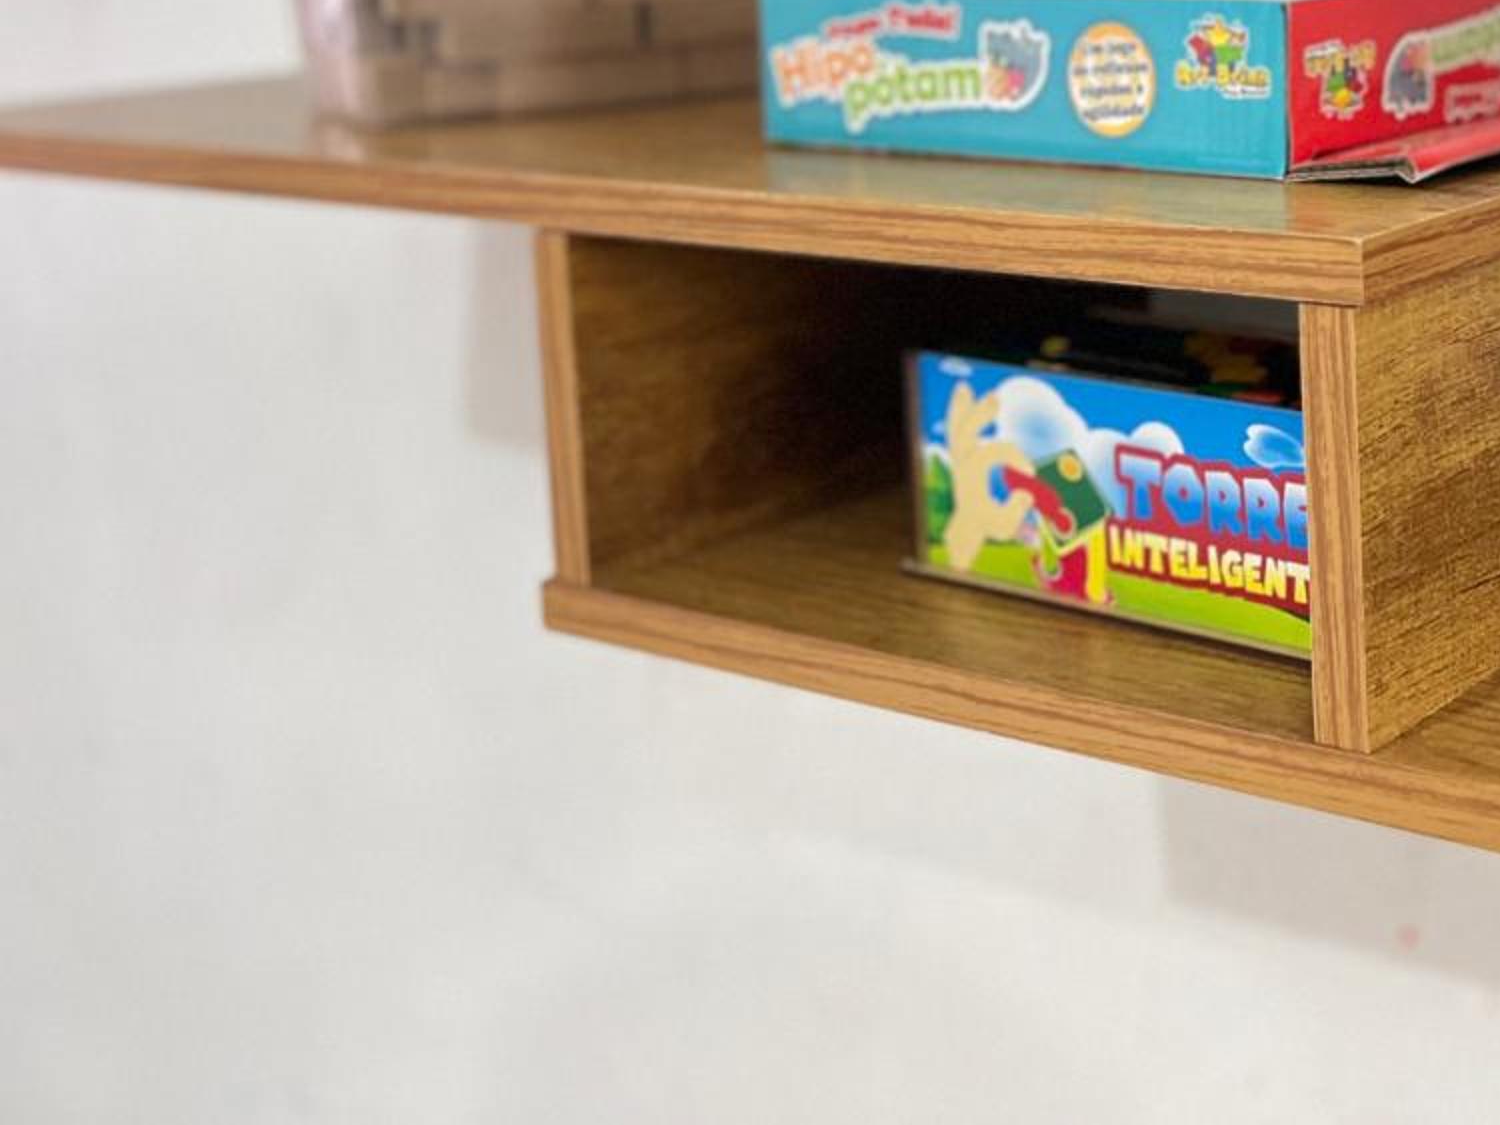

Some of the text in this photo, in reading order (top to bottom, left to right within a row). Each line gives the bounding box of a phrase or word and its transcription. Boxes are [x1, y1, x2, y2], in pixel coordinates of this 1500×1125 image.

[772, 41, 875, 98] Hipo
[845, 64, 982, 123] potam
[1118, 452, 1309, 550] TORRE
